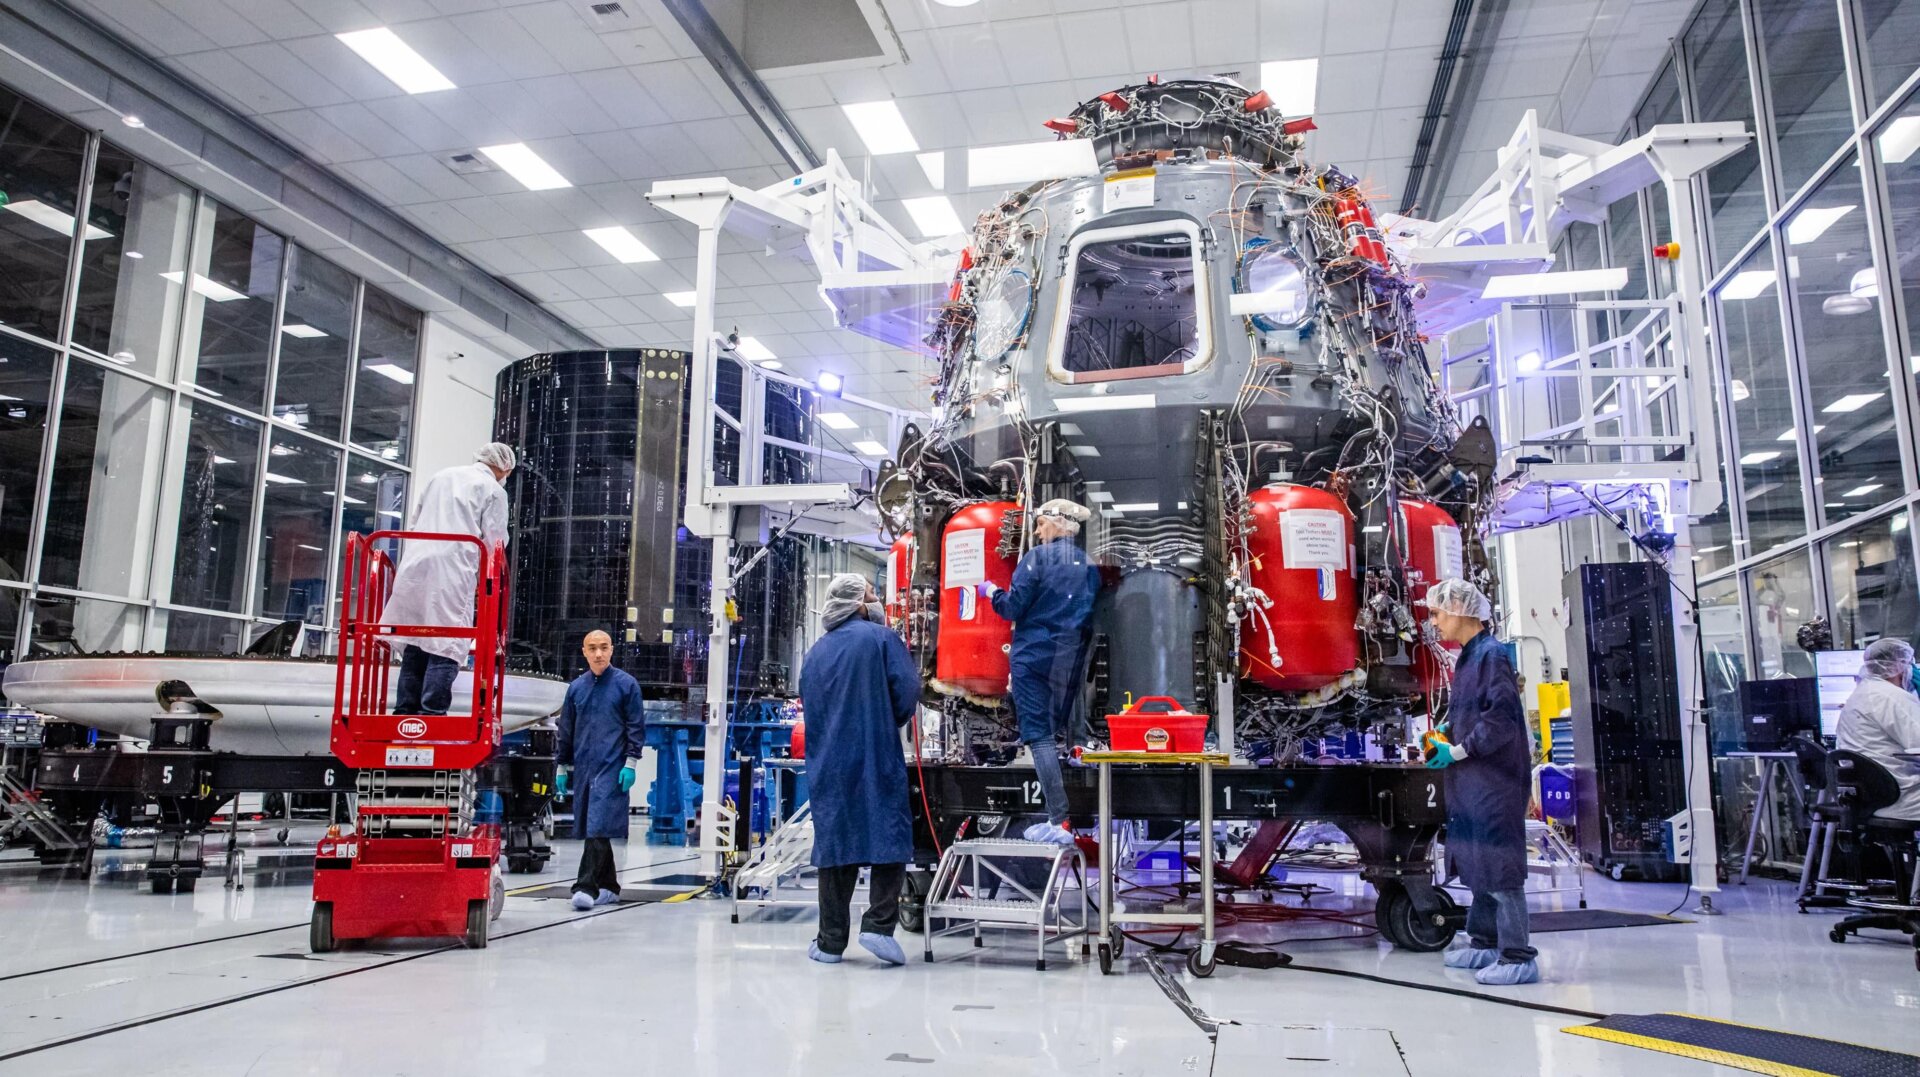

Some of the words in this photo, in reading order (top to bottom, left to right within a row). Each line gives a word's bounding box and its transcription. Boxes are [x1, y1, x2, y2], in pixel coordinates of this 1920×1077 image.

[656, 496, 664, 512] DEG
[73, 764, 80, 782] 4
[162, 765, 173, 784] 5
[324, 768, 335, 786] 6
[1023, 780, 1042, 804] 12
[1223, 785, 1232, 810] 1
[1426, 783, 1437, 808] 2
